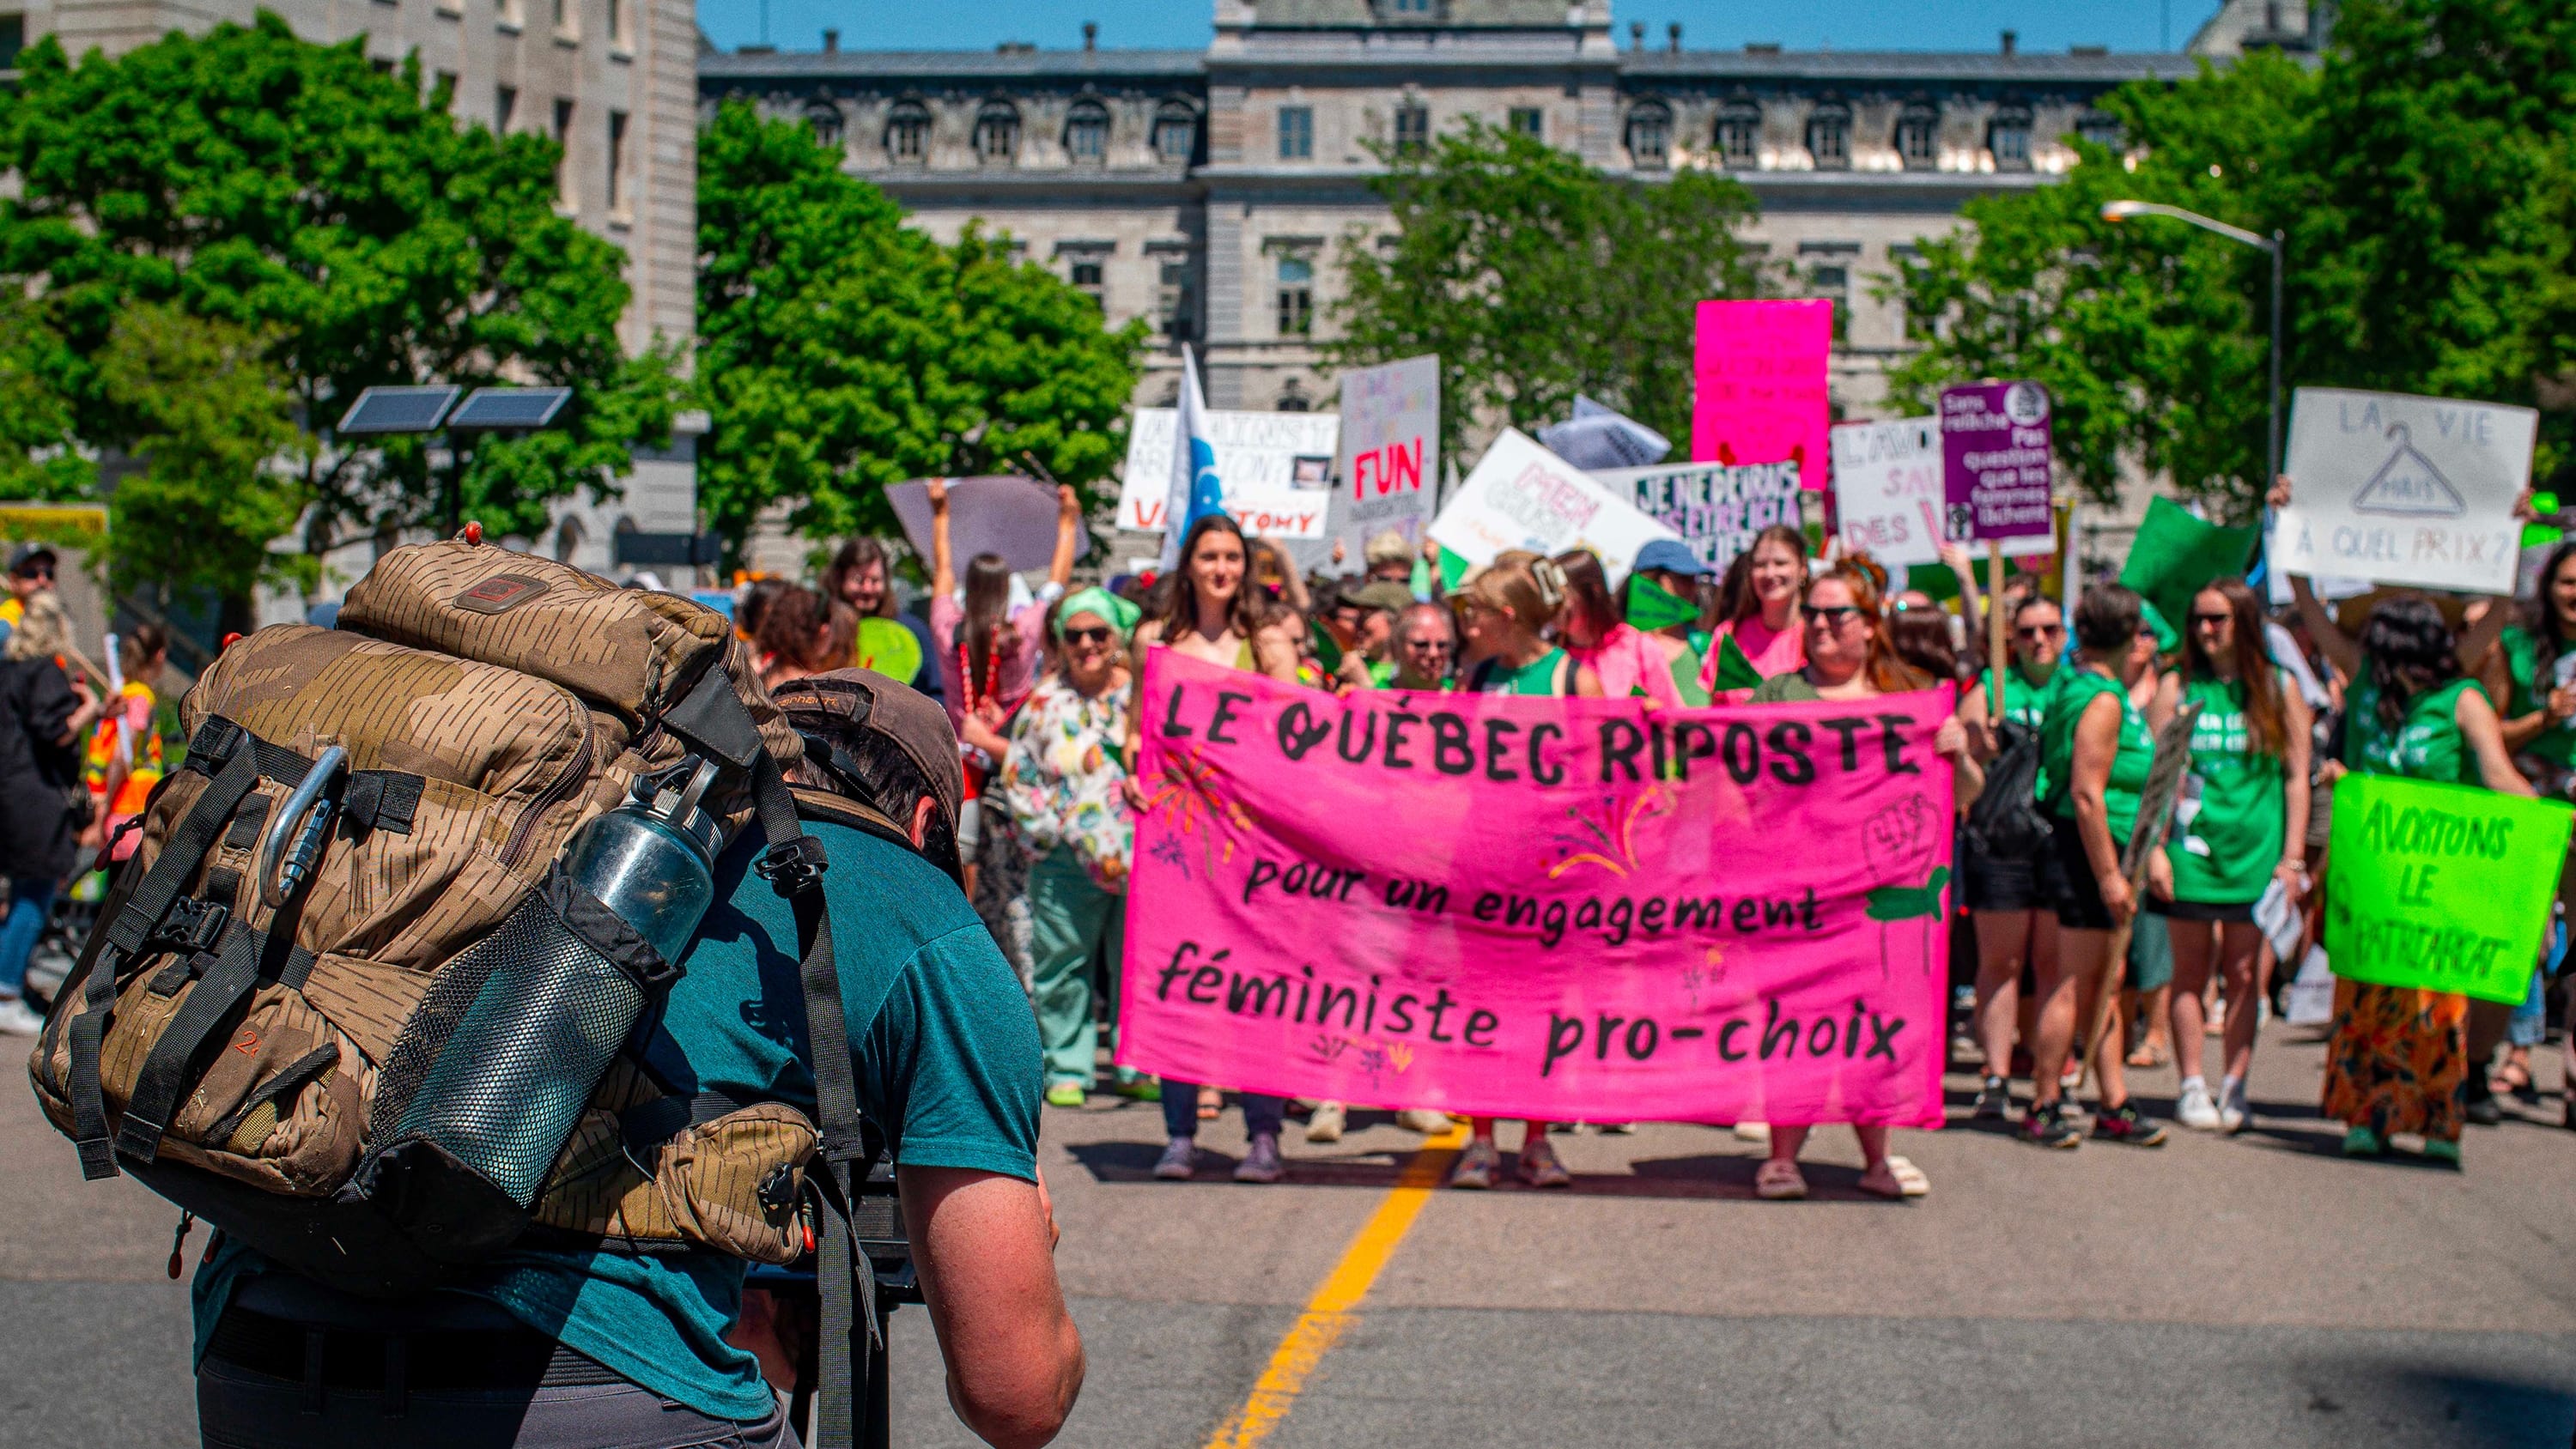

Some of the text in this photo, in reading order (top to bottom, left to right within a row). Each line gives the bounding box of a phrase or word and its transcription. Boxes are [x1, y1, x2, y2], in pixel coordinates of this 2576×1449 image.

[2339, 398, 2496, 447] LA VIE
[1352, 435, 1424, 501] FUN
[1846, 513, 1911, 550] DES
[2331, 524, 2400, 563] QUEL
[1163, 685, 1922, 785] LE QUÉBEC RIPOSTE
[2358, 798, 2514, 861] AVORTONS
[1243, 858, 1827, 948] pour un engagement
[2397, 863, 2440, 907] LE
[1157, 941, 1907, 1079] féministe pro-choix
